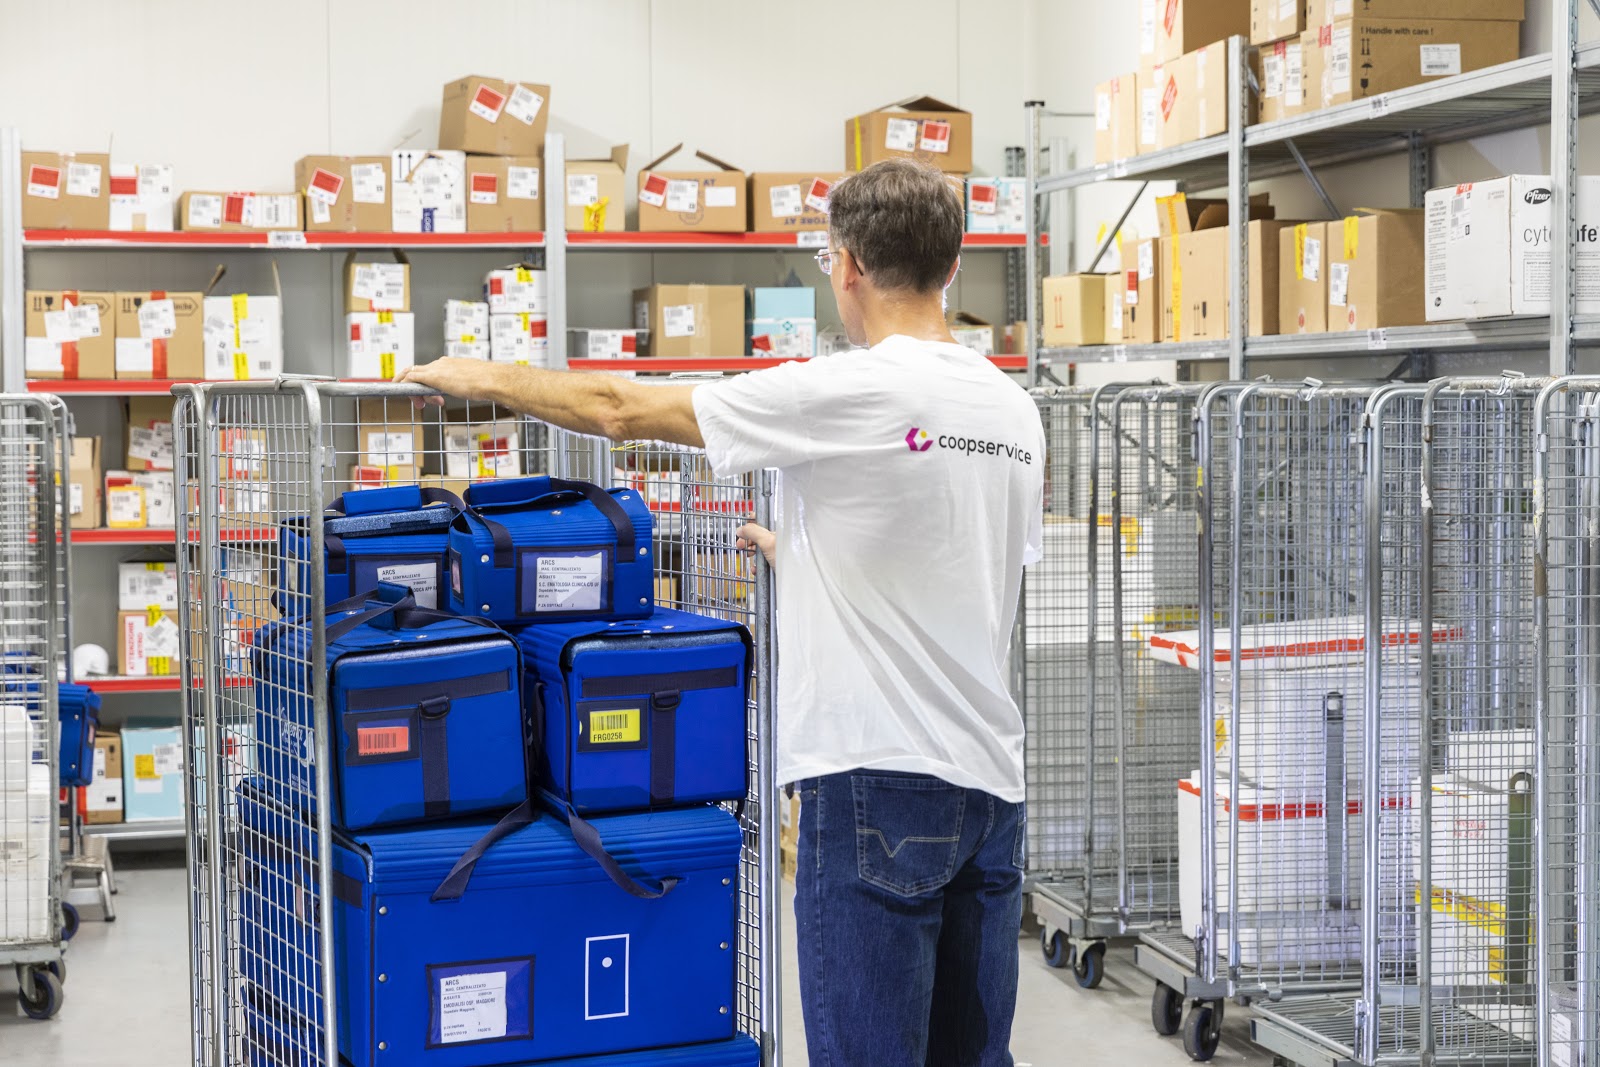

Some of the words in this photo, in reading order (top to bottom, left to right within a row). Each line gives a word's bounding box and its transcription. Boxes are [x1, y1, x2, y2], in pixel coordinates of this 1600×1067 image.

[1366, 26, 1392, 34] Handle
[1526, 190, 1550, 204] Pfizer
[938, 435, 1032, 464] coopservice
[594, 732, 622, 742] FRG0258
